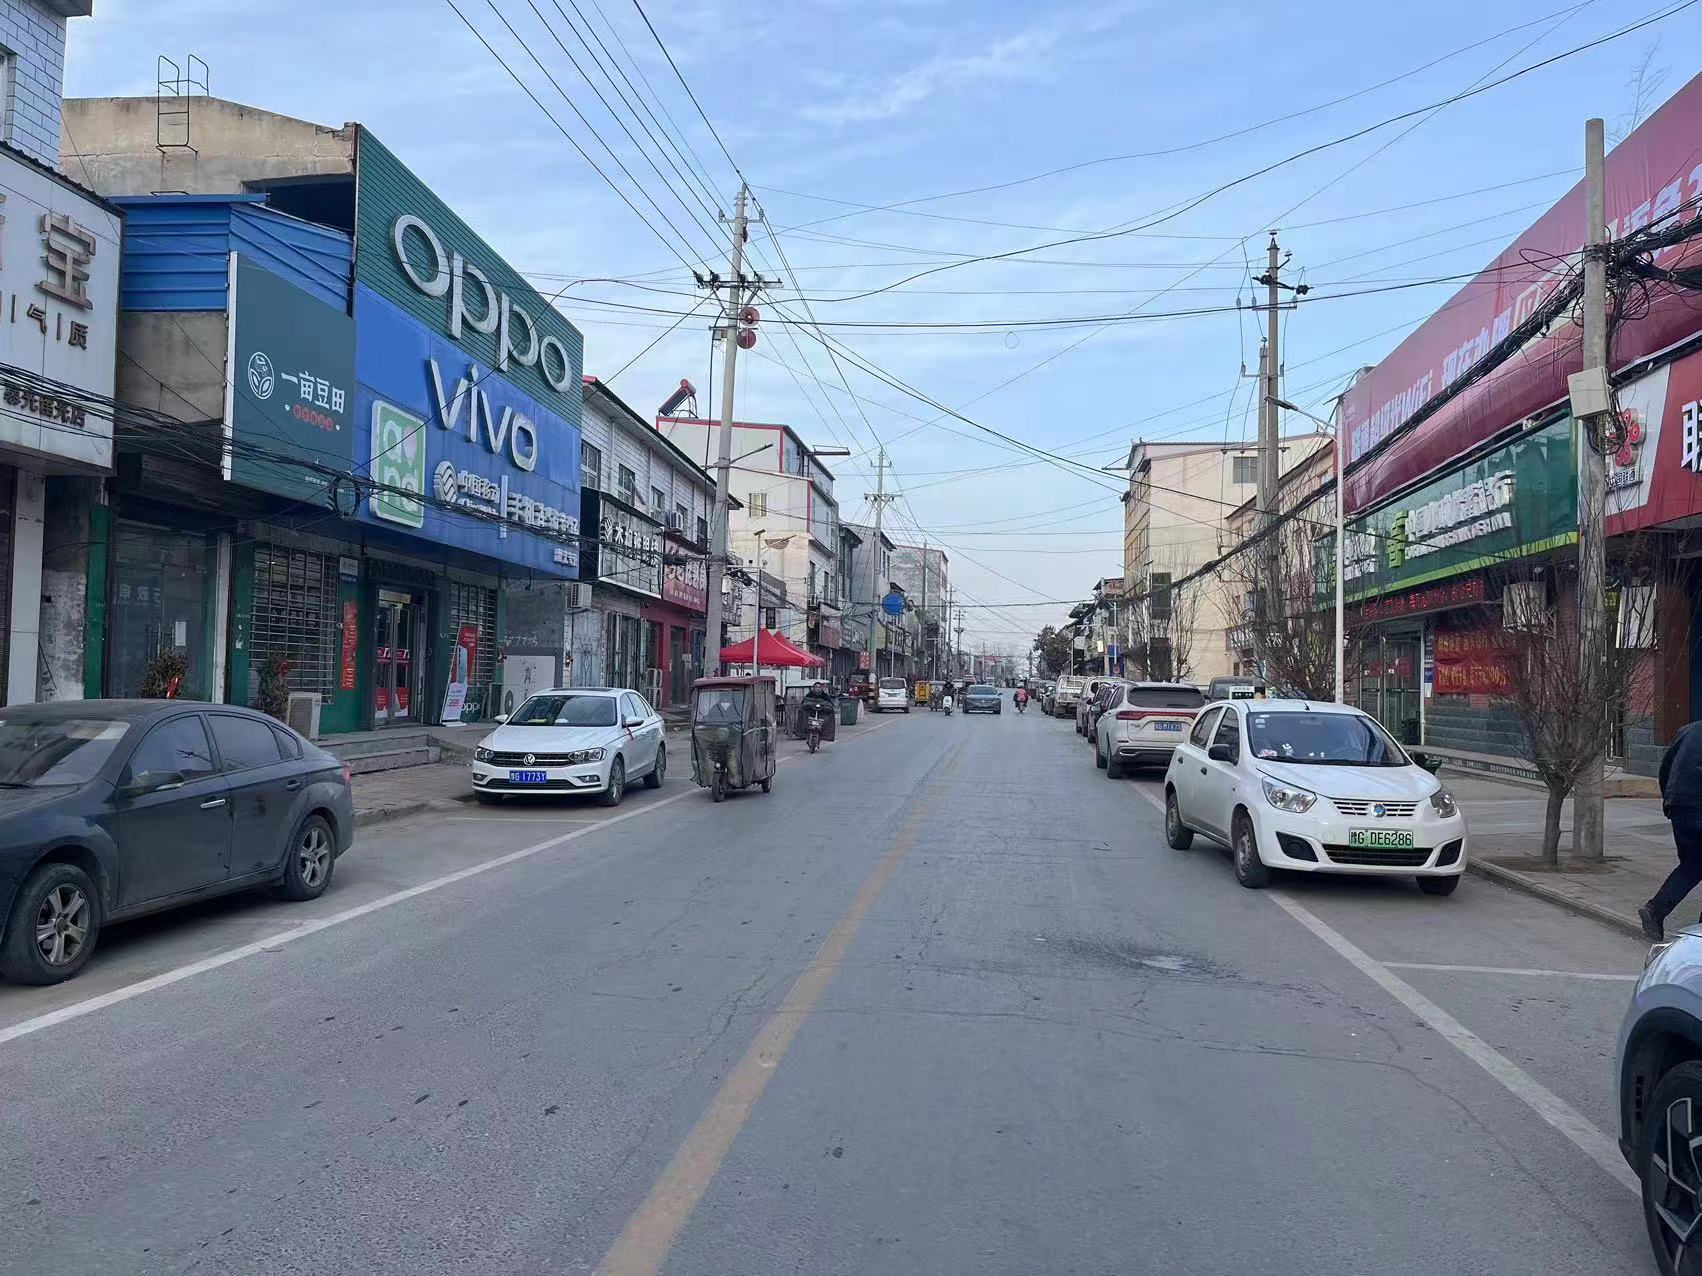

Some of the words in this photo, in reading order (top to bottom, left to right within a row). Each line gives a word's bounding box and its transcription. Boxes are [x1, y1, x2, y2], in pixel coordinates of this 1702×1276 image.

[42, 213, 96, 311] 宝
[281, 370, 345, 414] 一亩豆田
[427, 356, 538, 472] vivo
